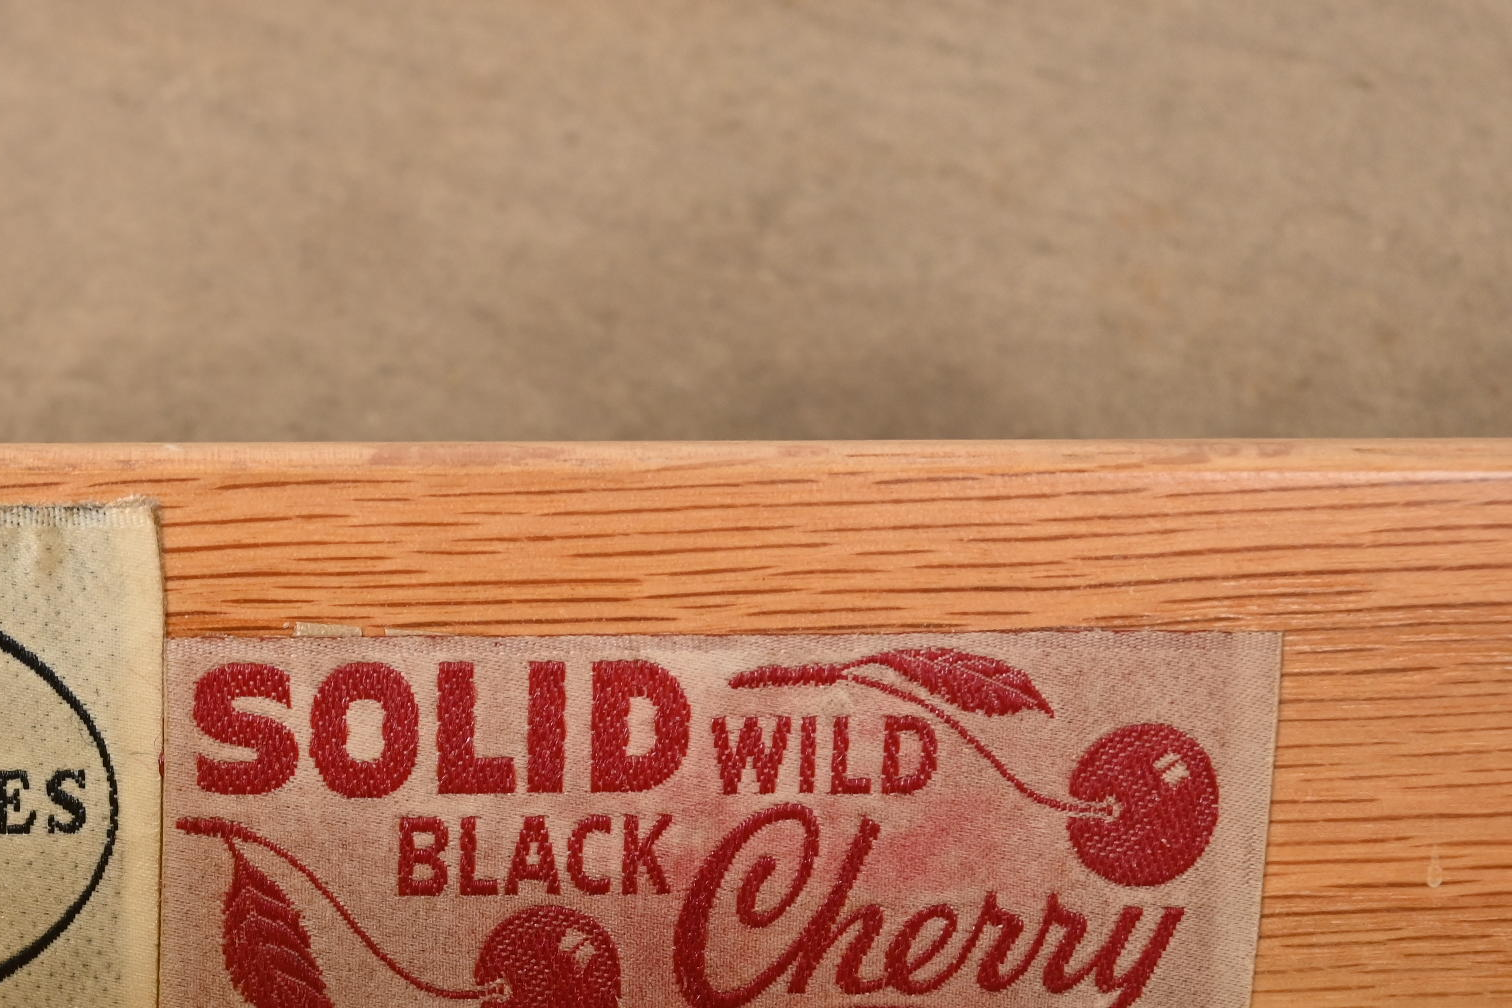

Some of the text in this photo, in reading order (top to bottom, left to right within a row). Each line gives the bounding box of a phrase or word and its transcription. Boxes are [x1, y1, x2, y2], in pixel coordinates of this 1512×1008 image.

[191, 659, 690, 798] SOLID
[711, 714, 938, 796] WILD
[397, 814, 673, 898] BLACK
